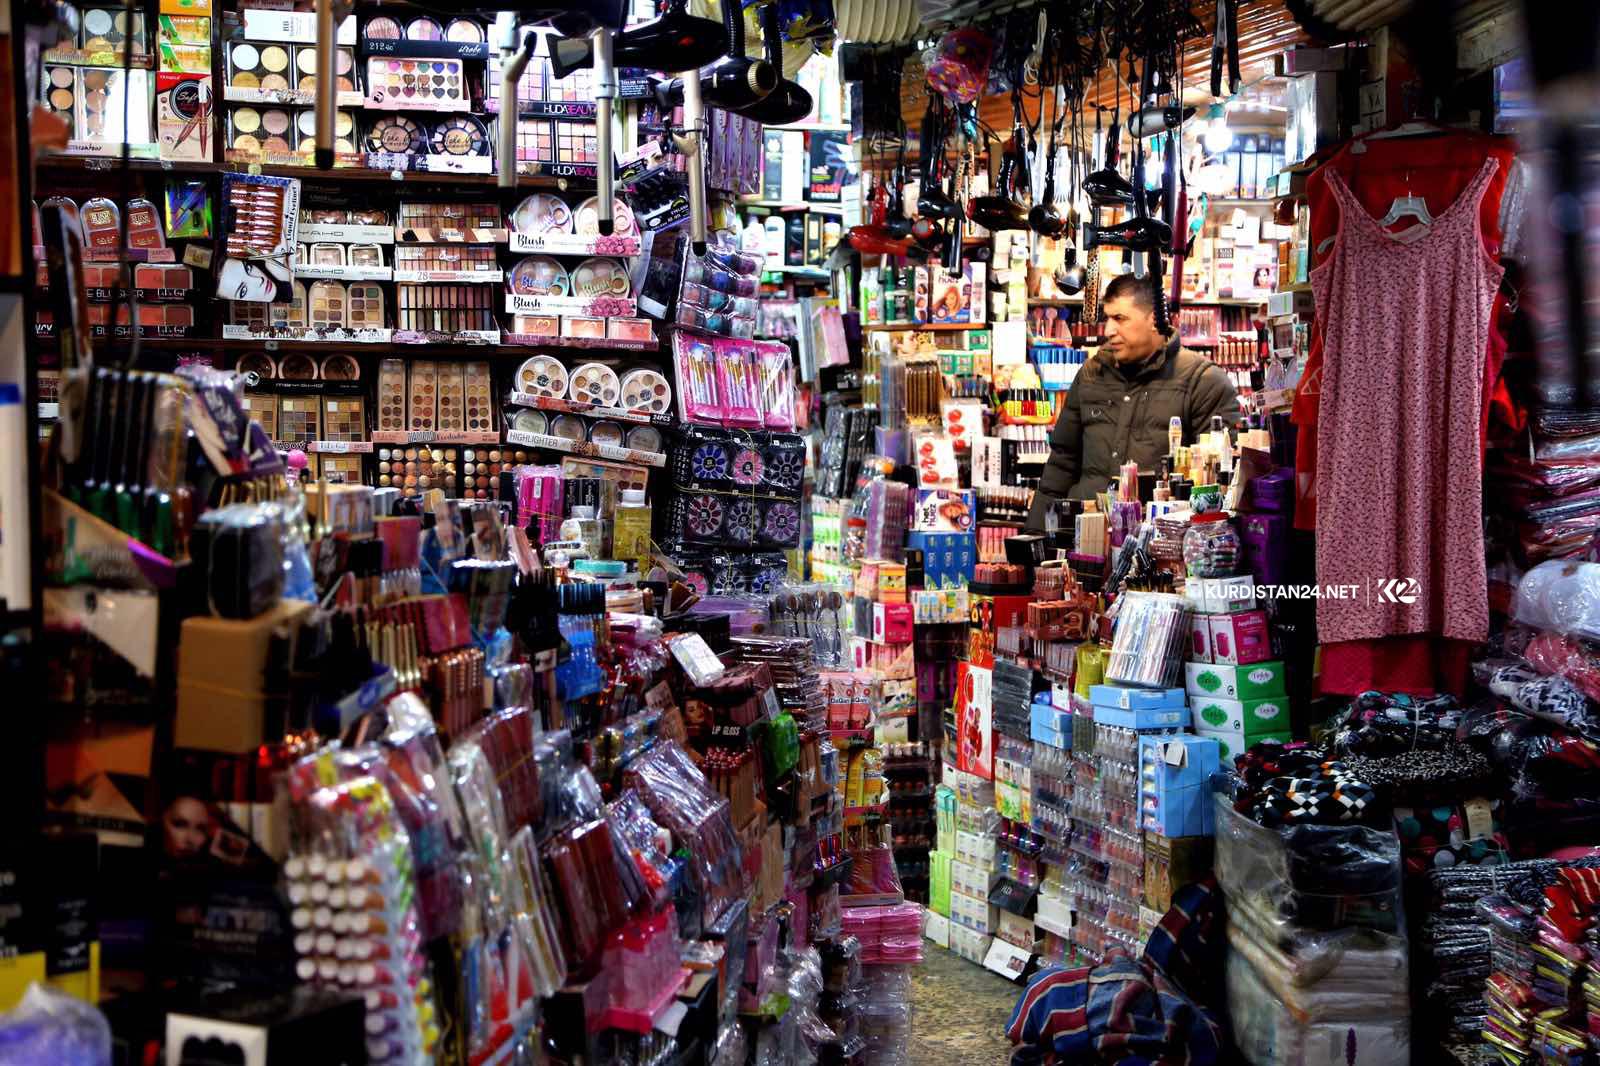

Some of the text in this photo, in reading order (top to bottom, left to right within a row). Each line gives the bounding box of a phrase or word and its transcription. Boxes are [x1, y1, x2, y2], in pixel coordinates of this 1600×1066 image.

[551, 166, 598, 176] HUDABEAU
[517, 233, 545, 248] Blush
[417, 272, 429, 281] 28
[513, 296, 541, 309] Blush
[509, 431, 559, 448] HIGHLIGHTER
[711, 725, 740, 736] LIP GLOSS
